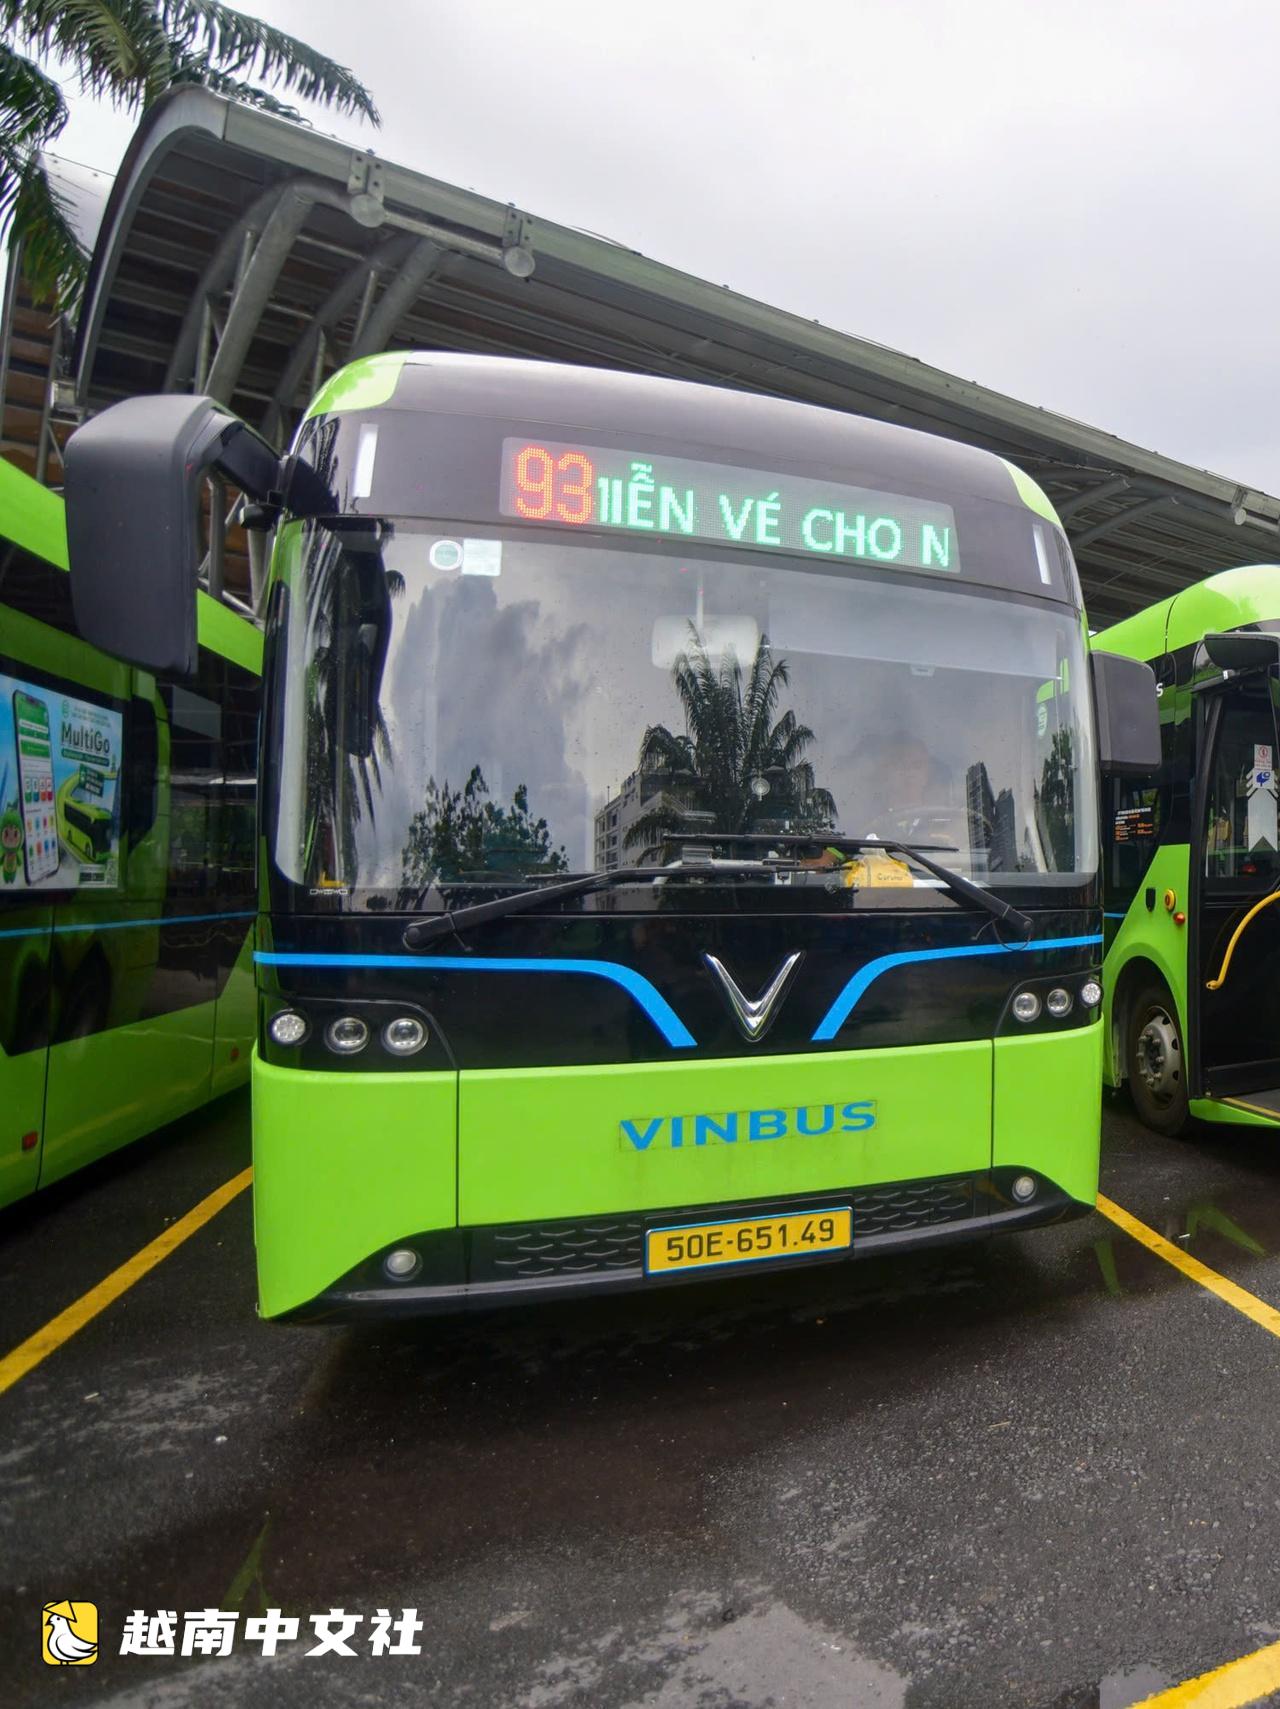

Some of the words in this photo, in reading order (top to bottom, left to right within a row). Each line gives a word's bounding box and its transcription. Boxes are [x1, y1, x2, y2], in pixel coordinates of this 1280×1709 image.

[516, 446, 593, 524] 93
[718, 491, 782, 545] VÉ
[802, 507, 902, 561] CHO
[922, 524, 950, 567] N
[61, 721, 110, 753] MultiGo
[619, 1100, 877, 1151] VINBUS
[666, 1218, 835, 1262] 50E-651.49
